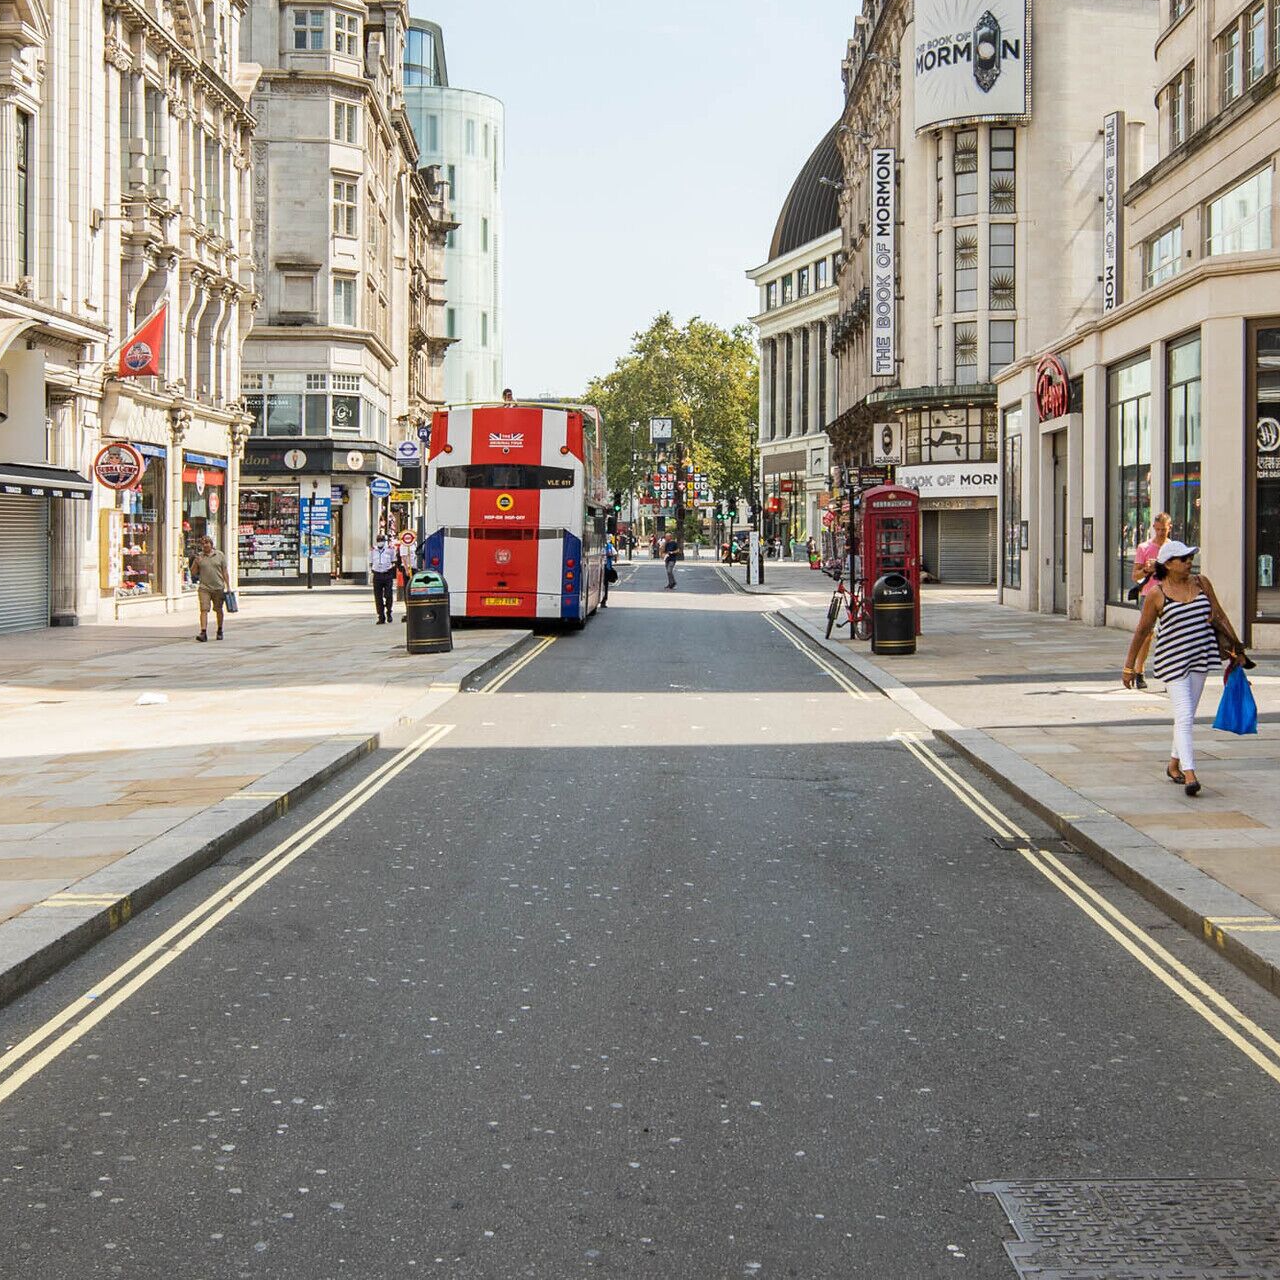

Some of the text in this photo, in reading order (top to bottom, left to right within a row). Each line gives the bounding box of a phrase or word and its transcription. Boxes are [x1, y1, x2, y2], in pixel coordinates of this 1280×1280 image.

[927, 34, 952, 50] BOOK
[955, 31, 972, 42] OF
[1105, 118, 1116, 159] THE
[1105, 169, 1116, 225] BOOK
[1105, 231, 1115, 259] OF
[876, 152, 891, 373] THE BOOK OF MORMON
[937, 474, 955, 486] OF
